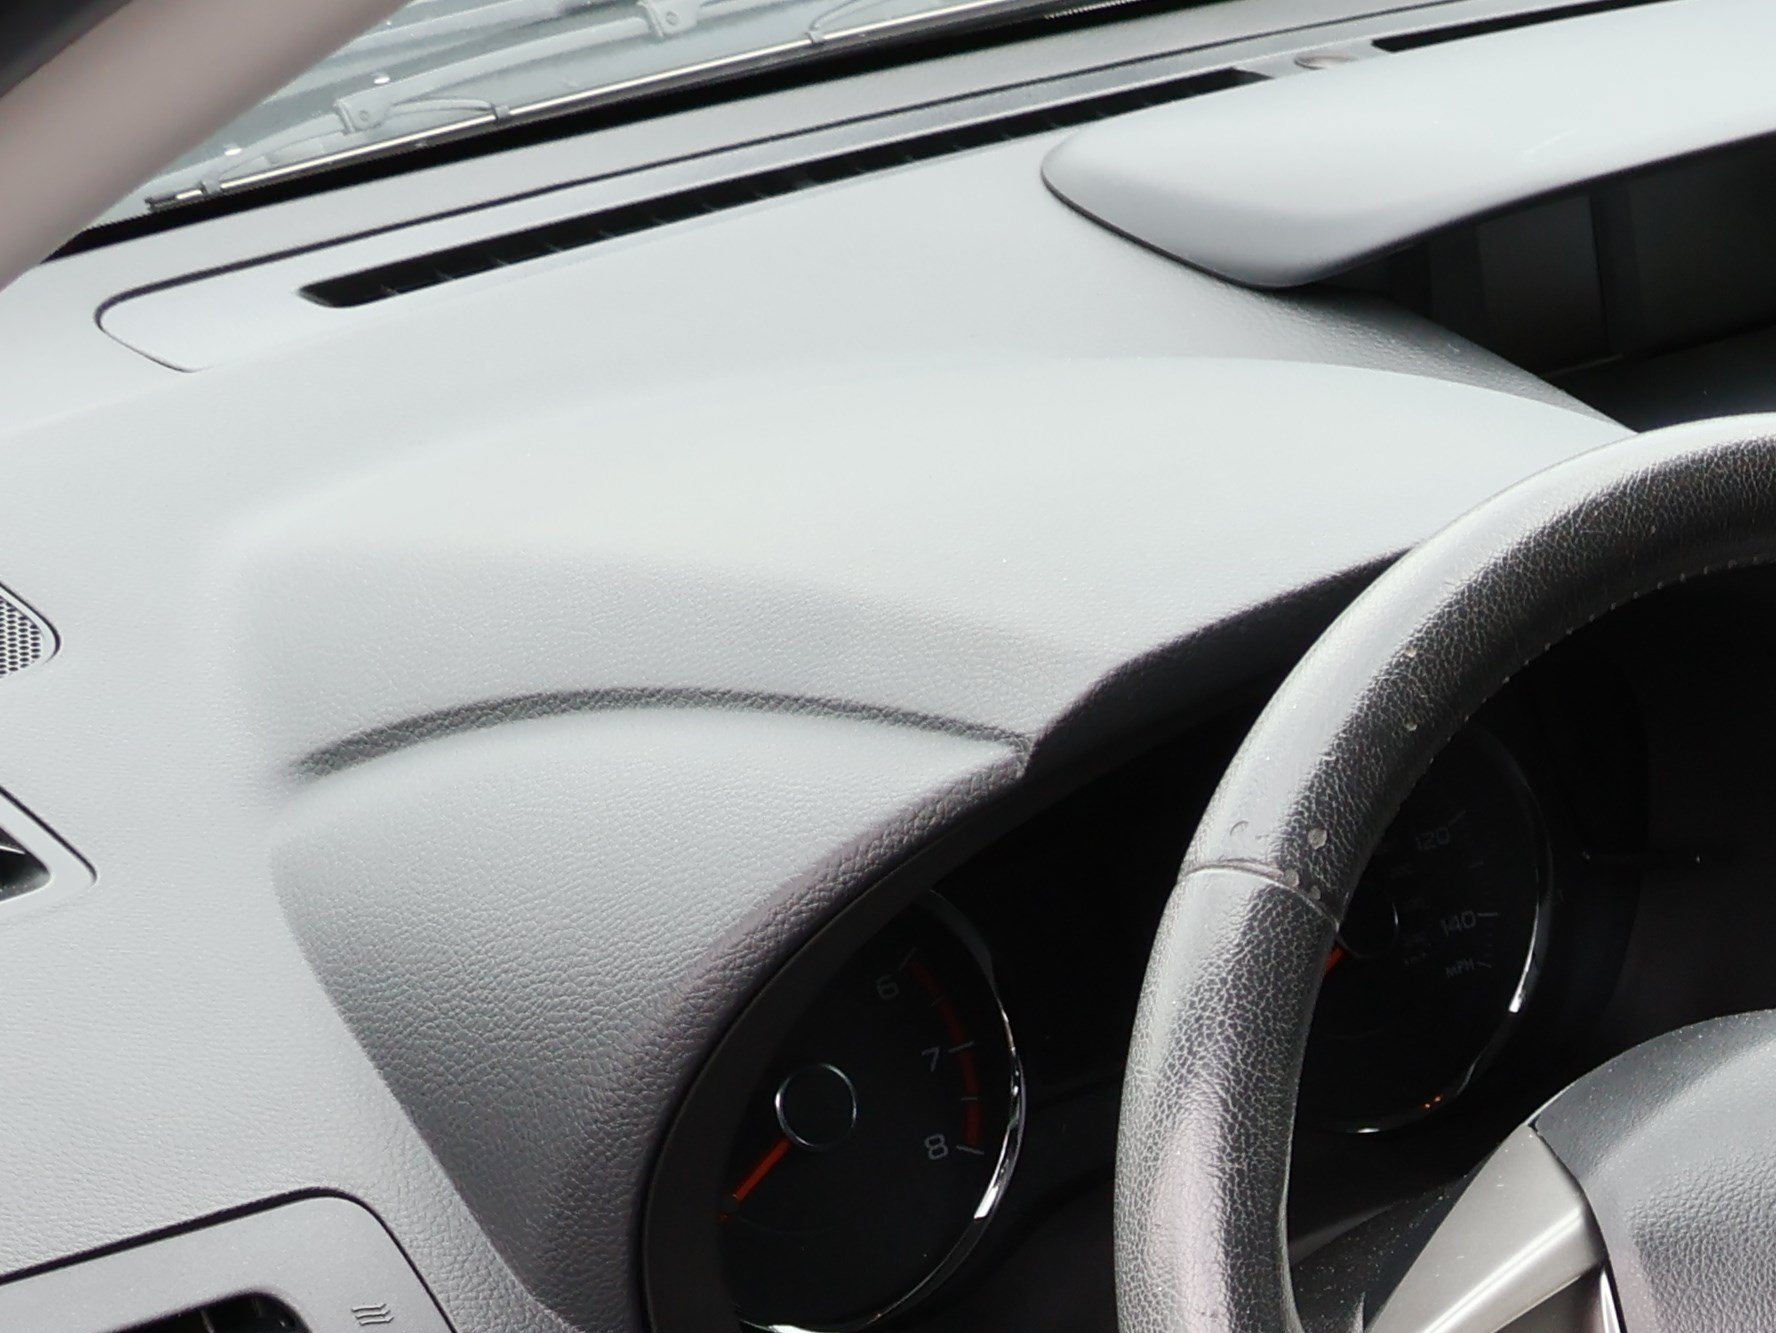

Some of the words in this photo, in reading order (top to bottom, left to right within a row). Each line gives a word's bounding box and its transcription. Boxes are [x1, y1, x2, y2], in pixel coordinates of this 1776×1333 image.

[1440, 910, 1477, 936] 140
[1445, 957, 1476, 978] MPH
[876, 975, 898, 1001] 6
[921, 1047, 942, 1071] 7
[924, 1134, 949, 1160] 8
